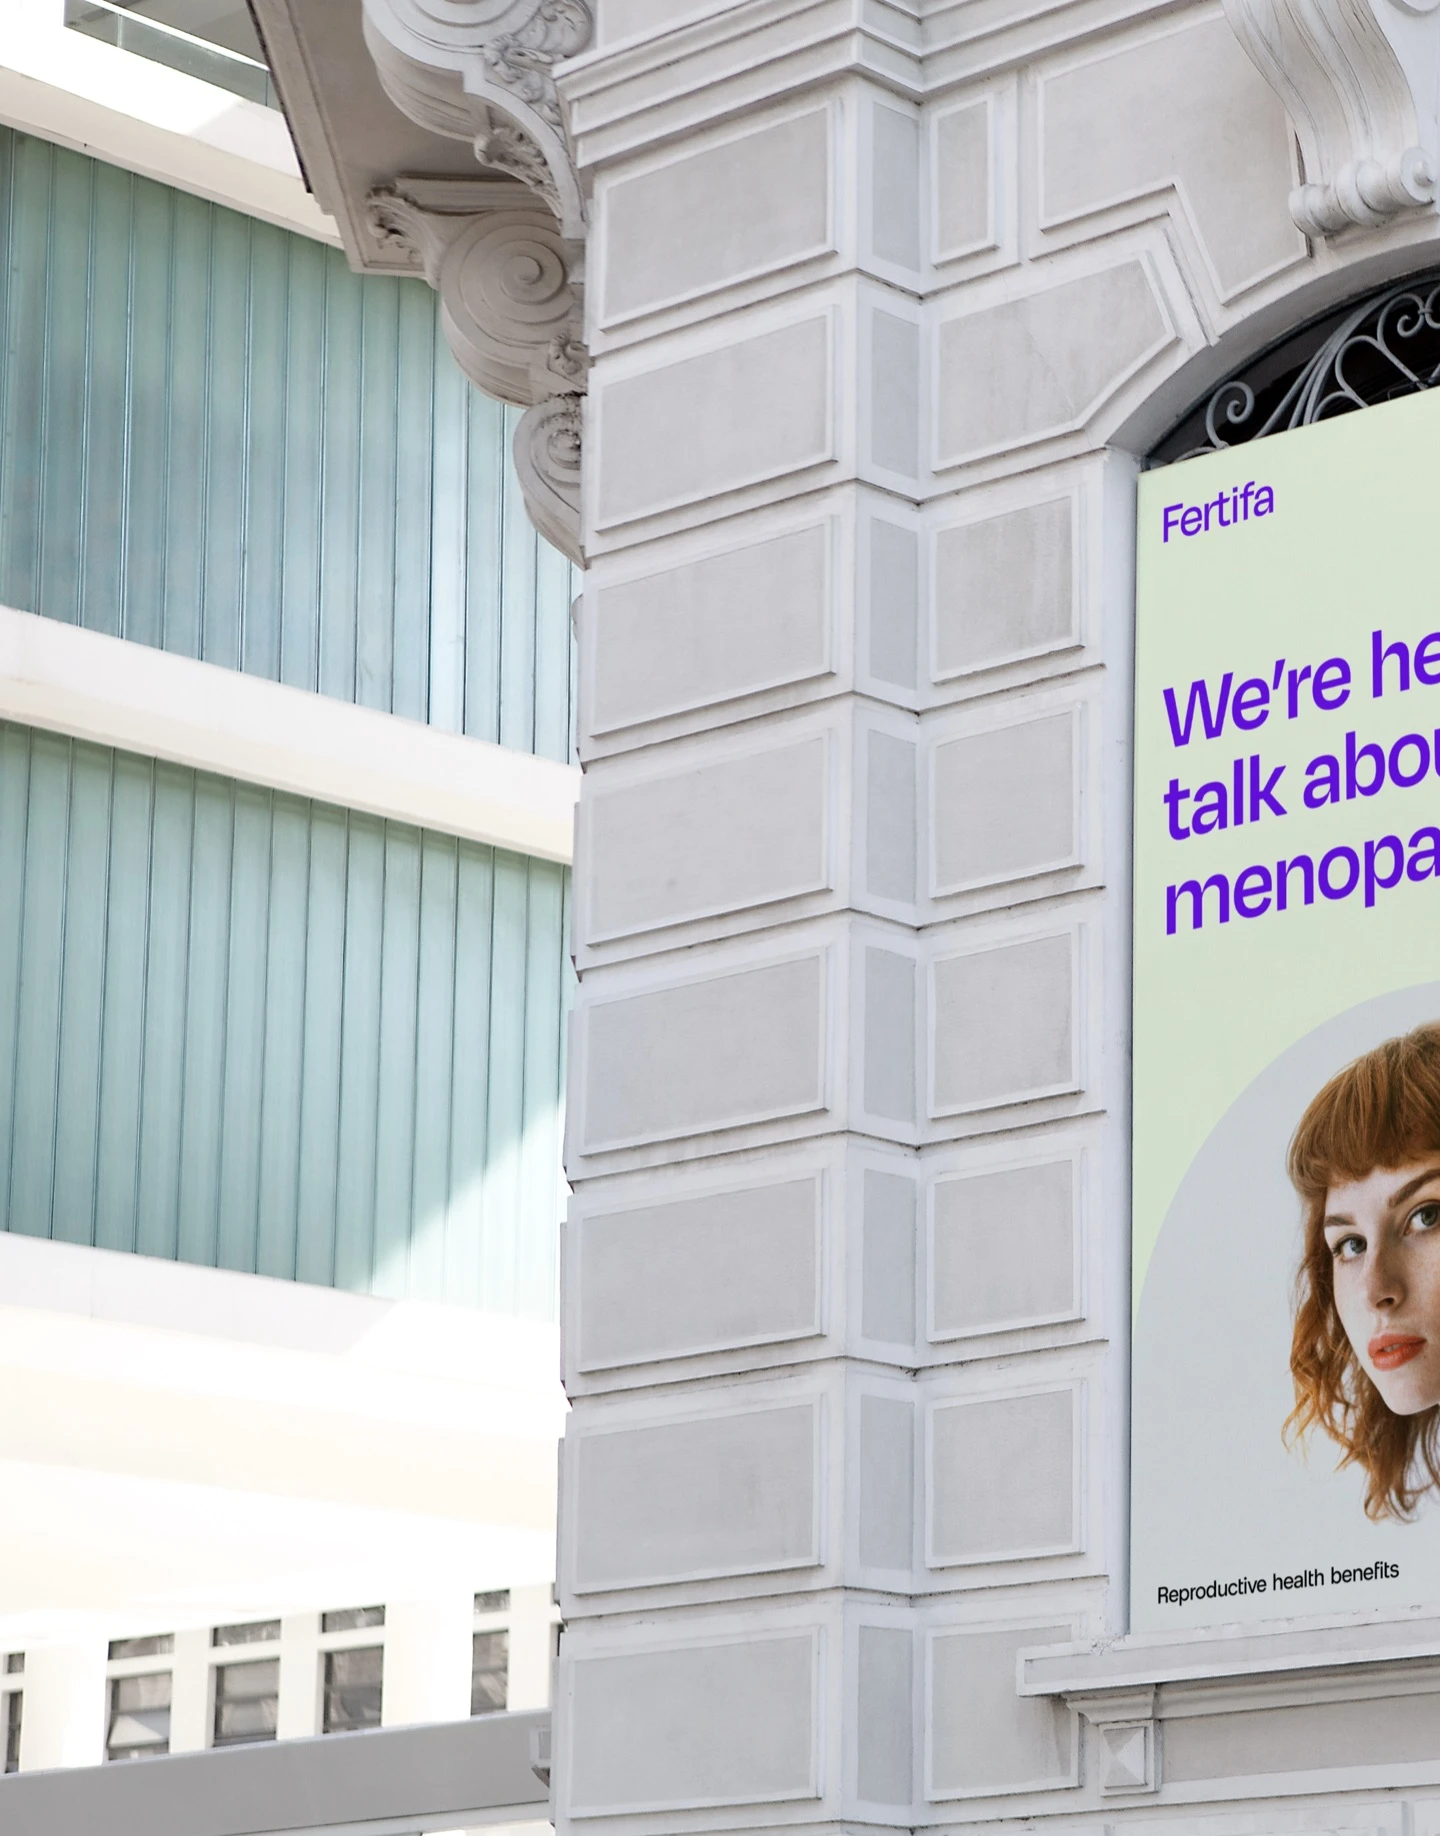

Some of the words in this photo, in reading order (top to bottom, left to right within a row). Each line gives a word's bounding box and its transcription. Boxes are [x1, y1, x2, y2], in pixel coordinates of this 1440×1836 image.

[1162, 480, 1275, 543] Fertifa
[1162, 656, 1353, 748] We're
[1162, 753, 1288, 841] talk
[1157, 1576, 1267, 1605] Reproductive
[1272, 1568, 1325, 1591] health
[1330, 1560, 1400, 1585] benefits
